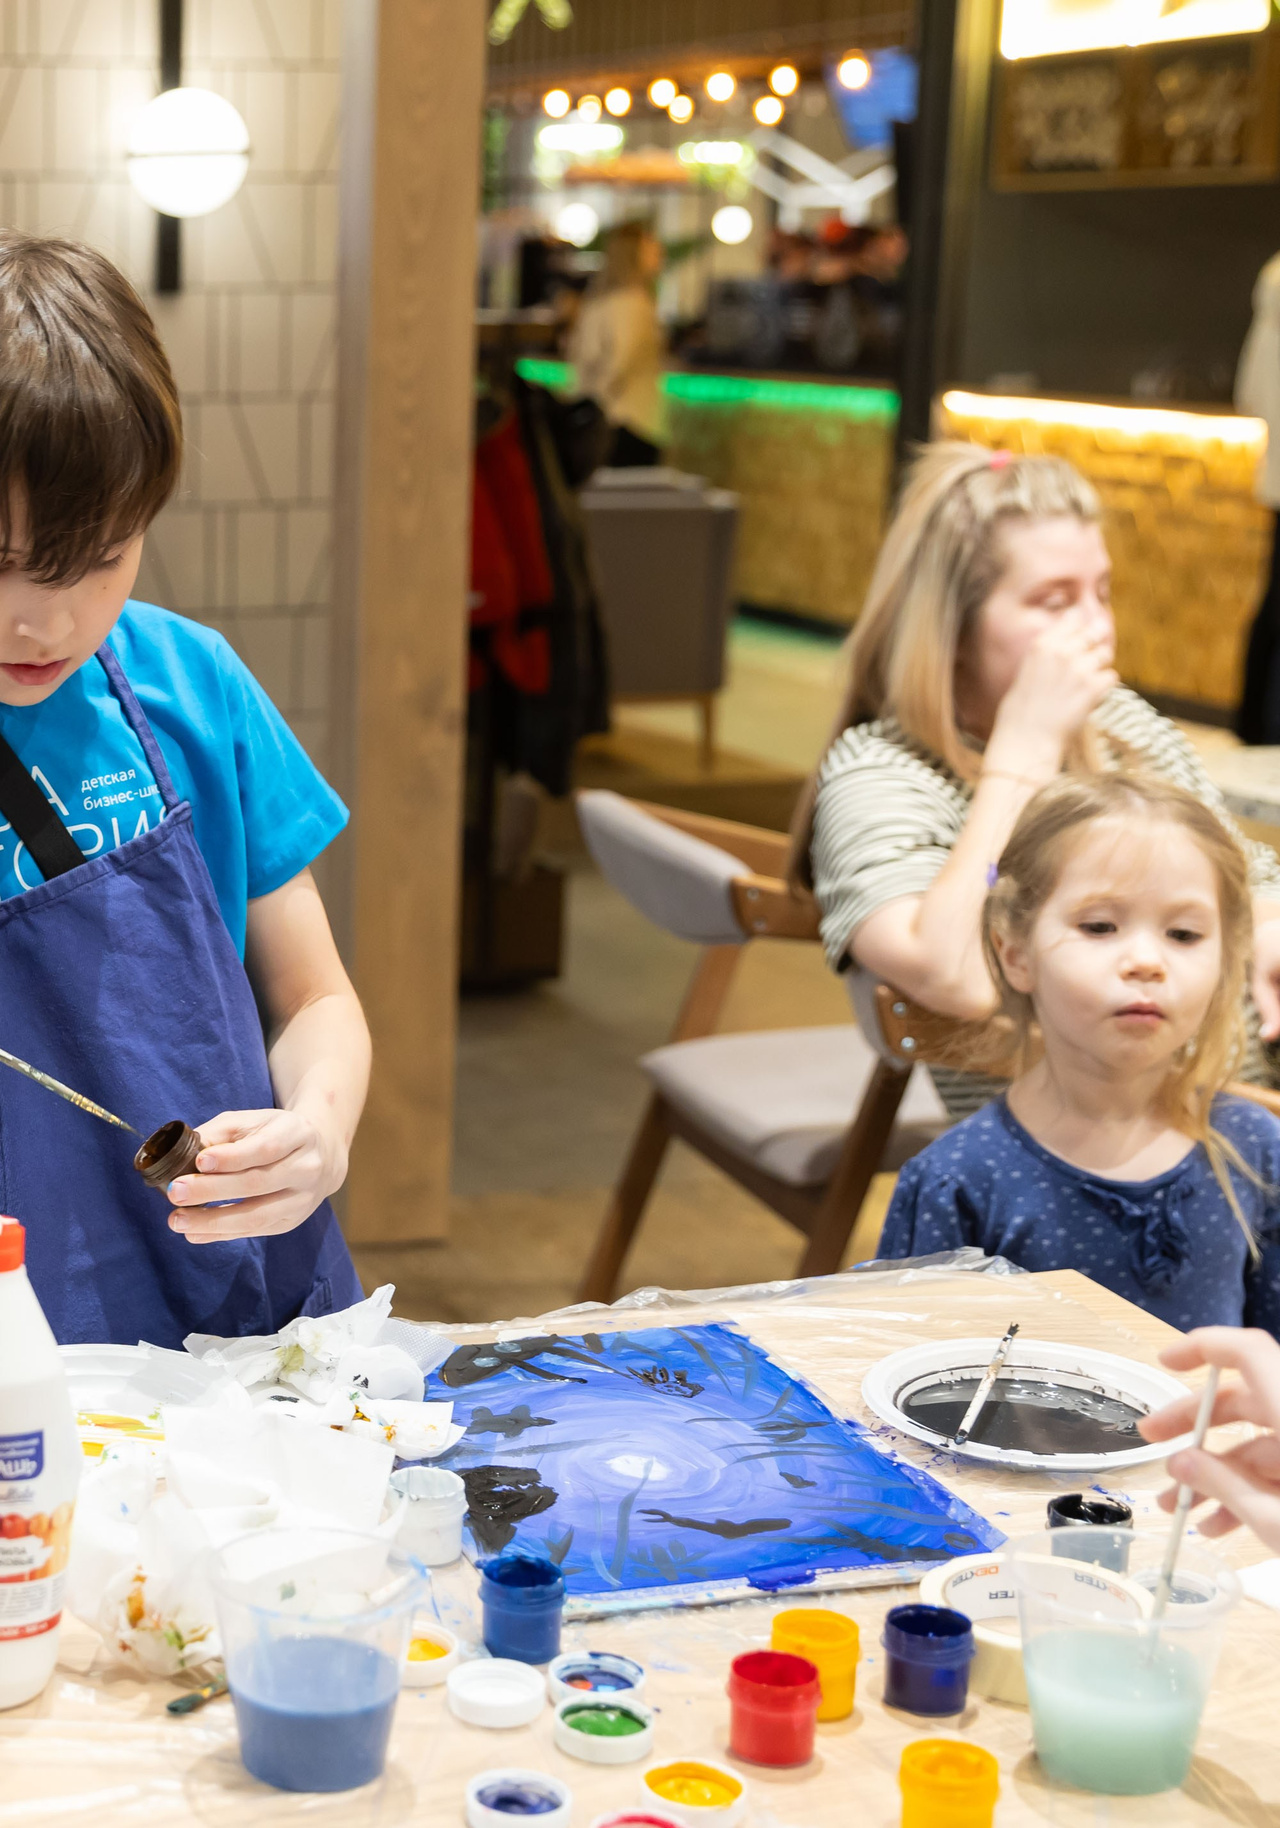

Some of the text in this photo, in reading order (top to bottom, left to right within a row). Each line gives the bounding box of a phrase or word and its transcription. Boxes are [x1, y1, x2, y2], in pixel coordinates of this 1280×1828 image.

[81, 768, 136, 793] детская
[83, 784, 160, 811] бизнес-шк
[952, 1565, 999, 1587] DEXTER
